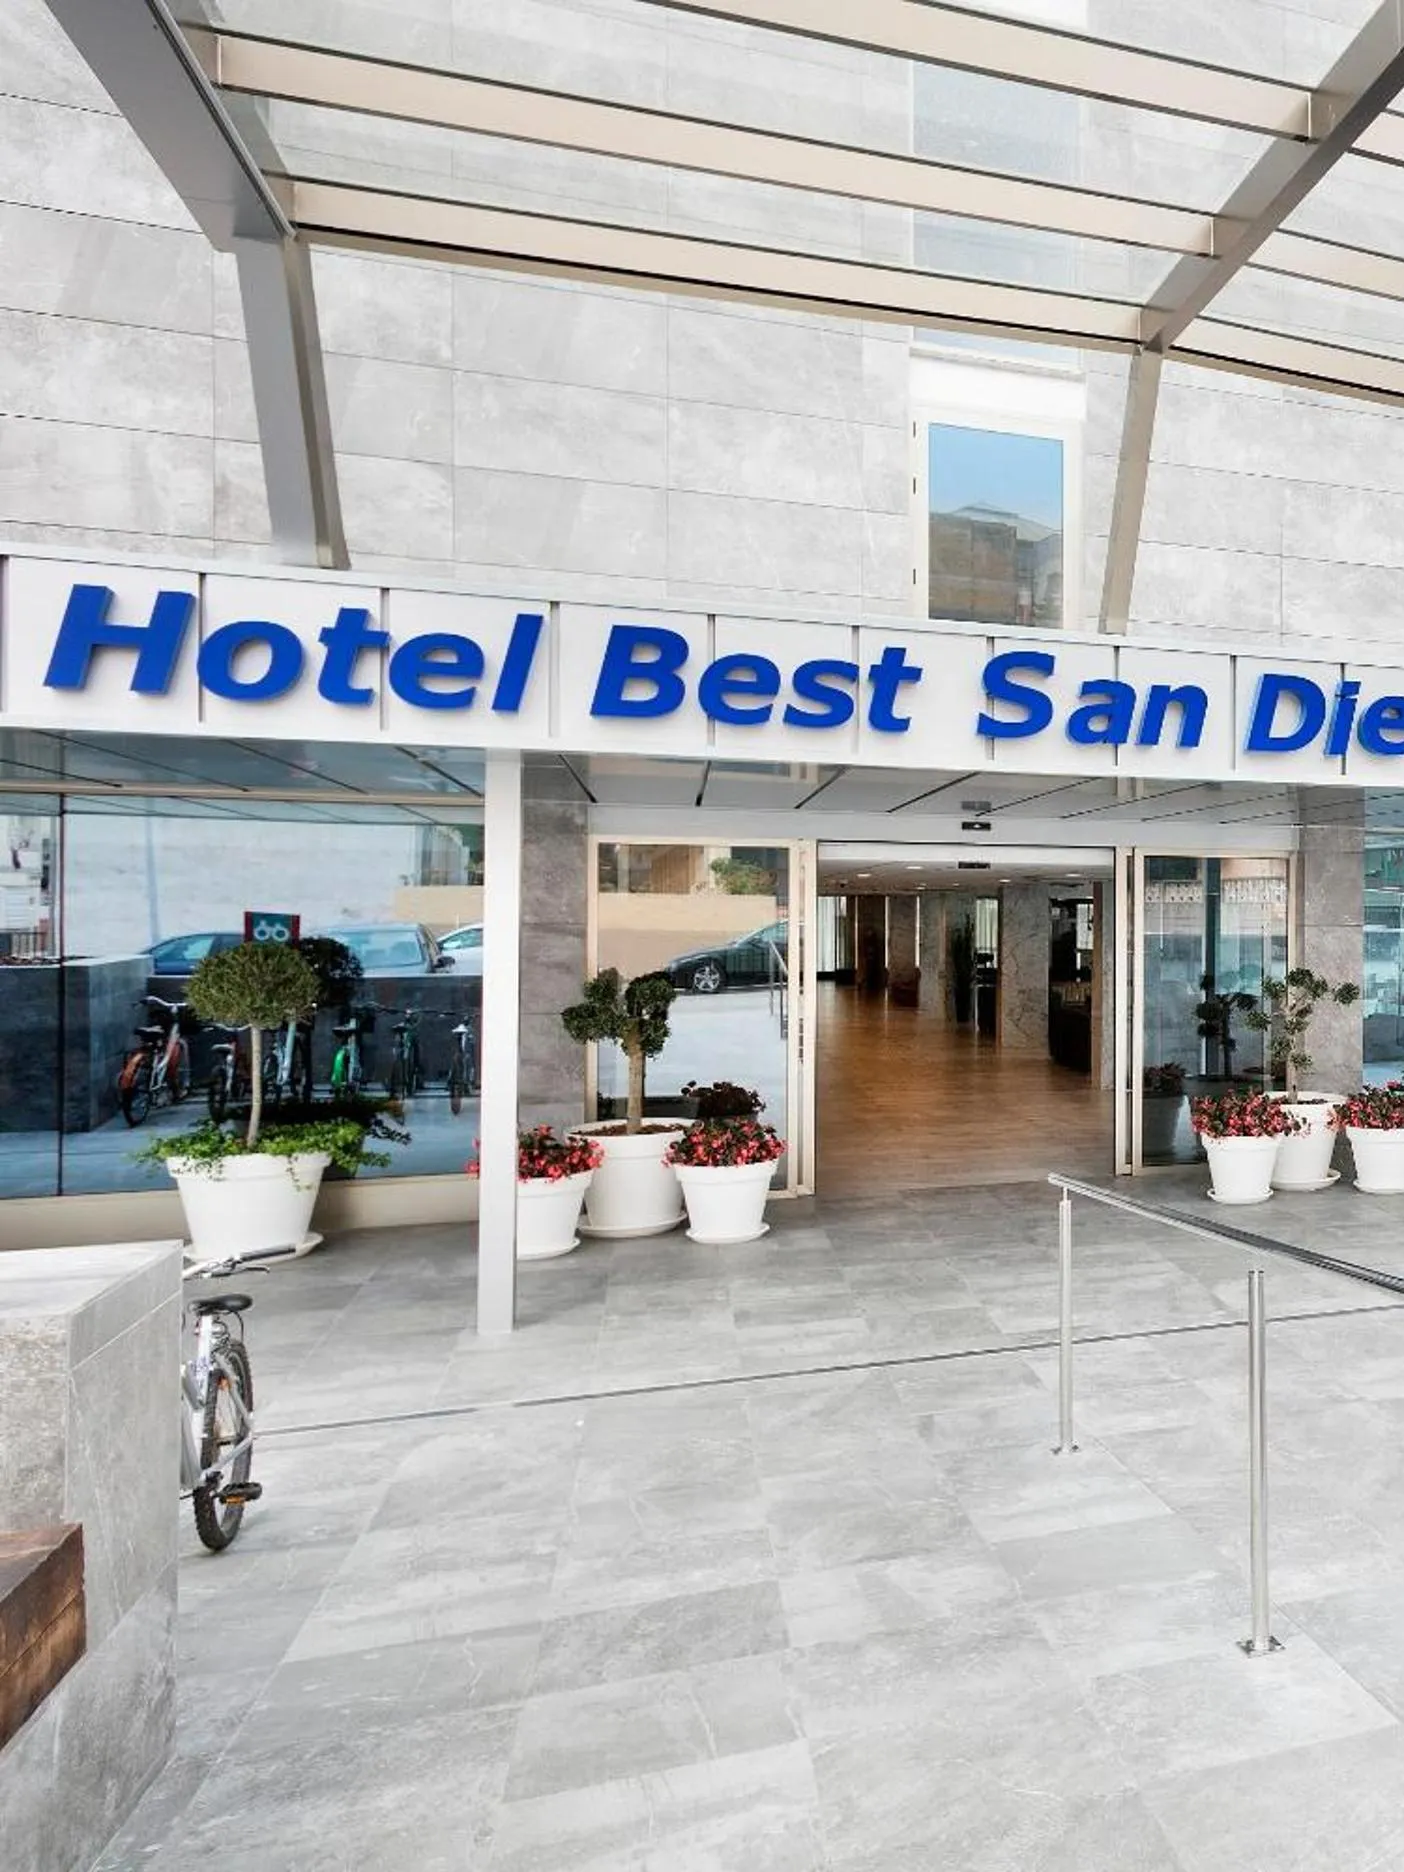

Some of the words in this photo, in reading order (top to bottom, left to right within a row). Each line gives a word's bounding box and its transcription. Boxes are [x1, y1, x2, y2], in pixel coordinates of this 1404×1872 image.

[43, 584, 544, 713] Hotel
[589, 624, 923, 735] Best
[976, 651, 1209, 750] San
